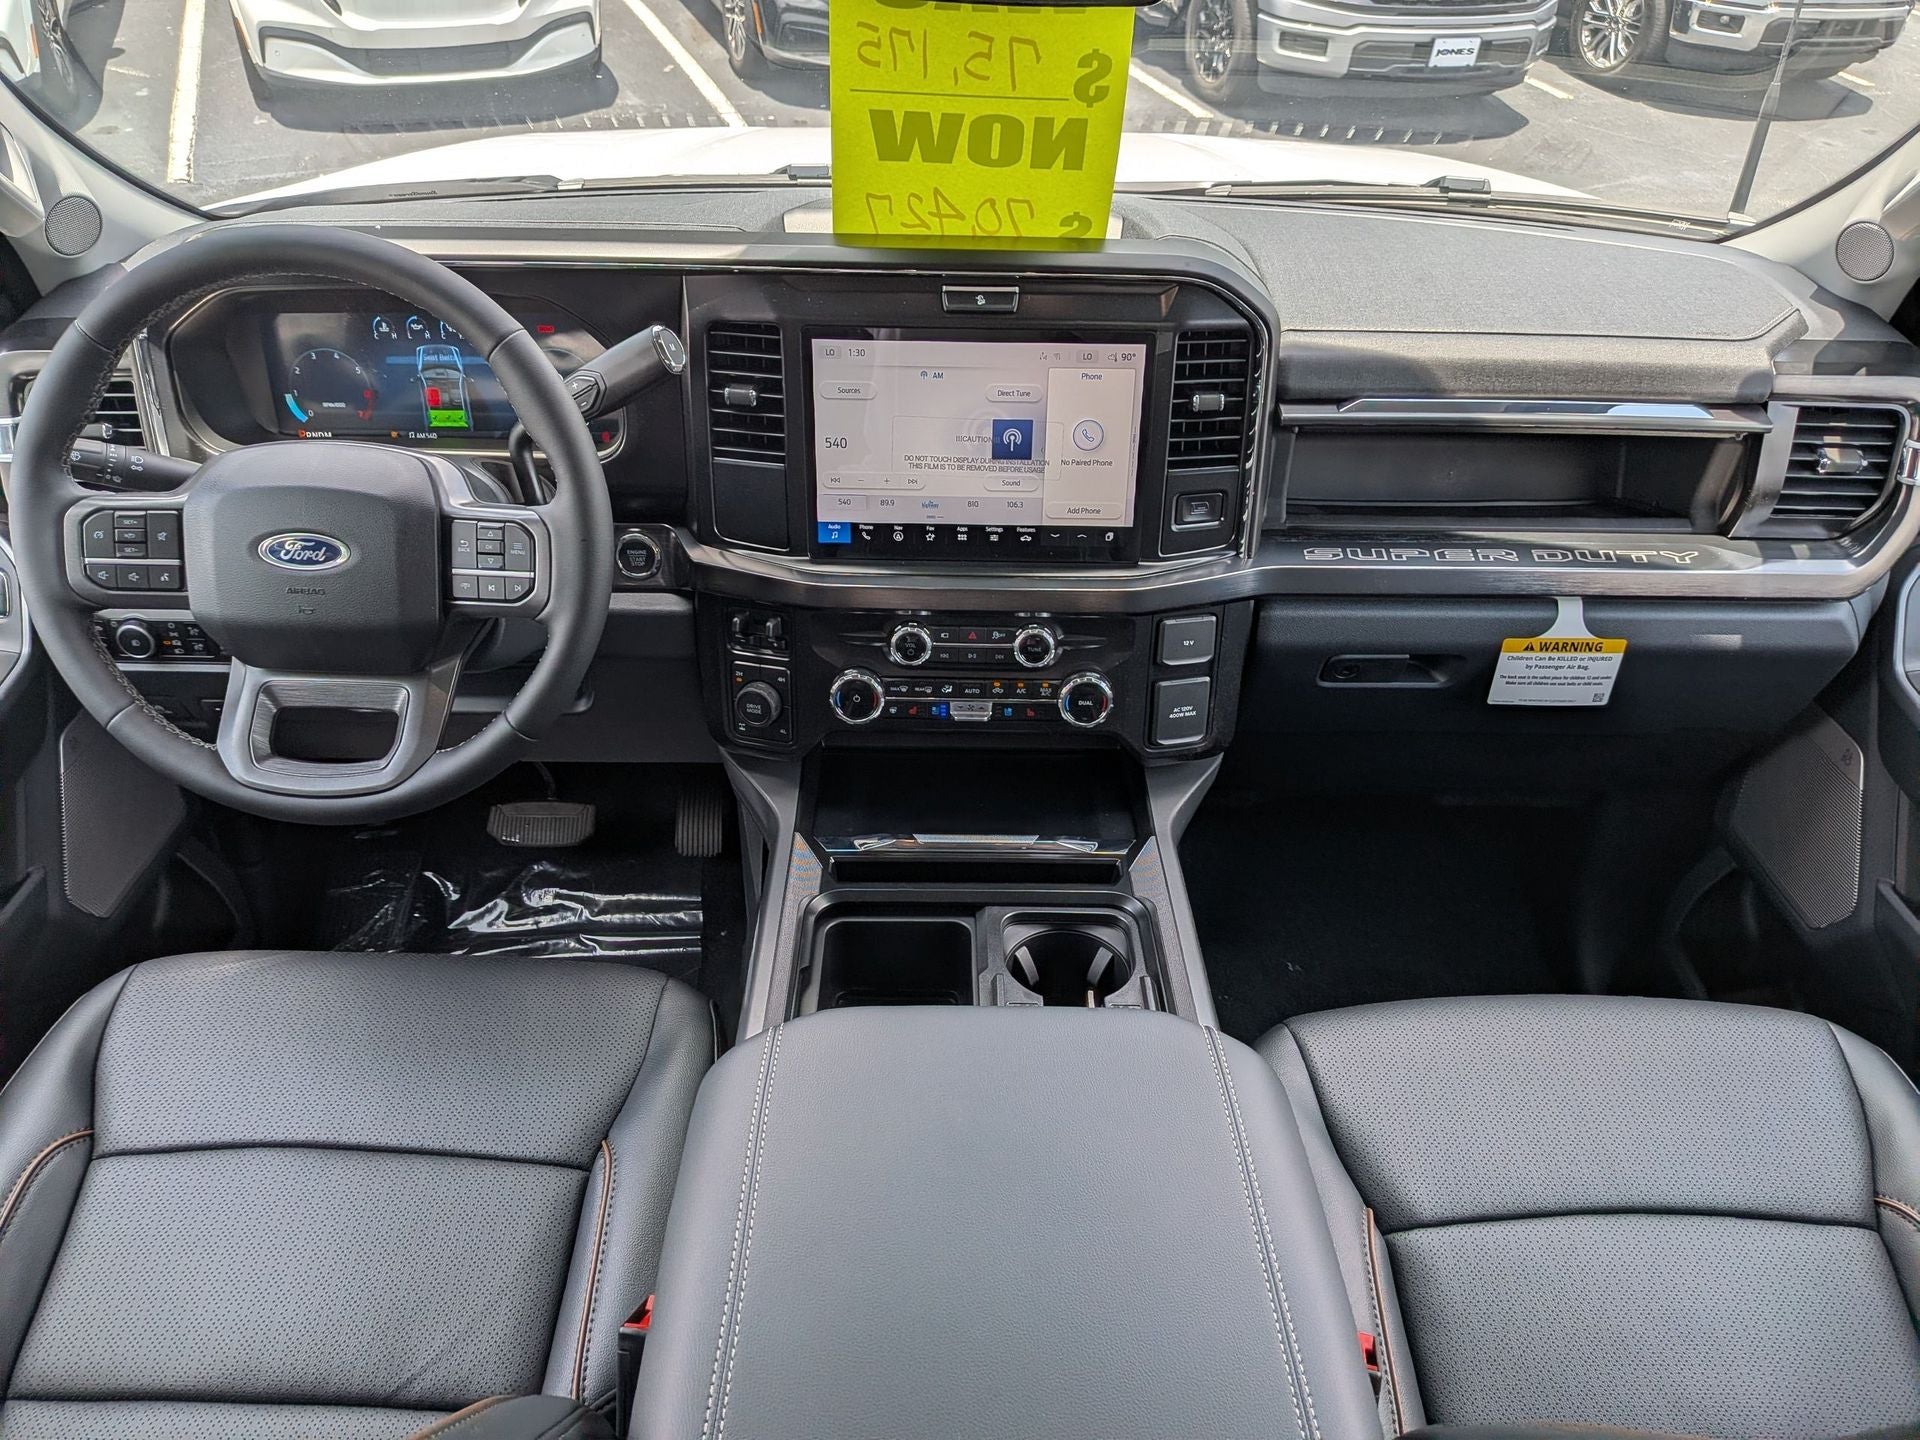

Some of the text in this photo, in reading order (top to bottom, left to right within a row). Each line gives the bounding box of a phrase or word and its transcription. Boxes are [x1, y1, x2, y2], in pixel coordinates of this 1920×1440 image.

[1435, 47, 1476, 58] JONES
[825, 348, 835, 357] LO
[848, 348, 866, 357] 1:30
[1083, 352, 1093, 360] LO
[932, 372, 944, 380] AM
[1081, 372, 1103, 381] Phone
[837, 386, 861, 395] Sources
[997, 389, 1031, 398] Direct Tune
[825, 436, 848, 449] 540
[904, 454, 914, 462] DO
[953, 456, 979, 464] DISPLAY
[1061, 459, 1113, 467] No Paired Phone
[966, 464, 997, 472] REMOVED
[998, 465, 1023, 473] BEFORE
[1001, 479, 1021, 487] Sound
[838, 498, 851, 506] 540
[880, 499, 895, 507] 89.9
[1067, 507, 1101, 515] Add Phone
[280, 540, 327, 562] Ford
[1303, 547, 1699, 565] SUPER DUTY
[1538, 641, 1604, 653] WARNING
